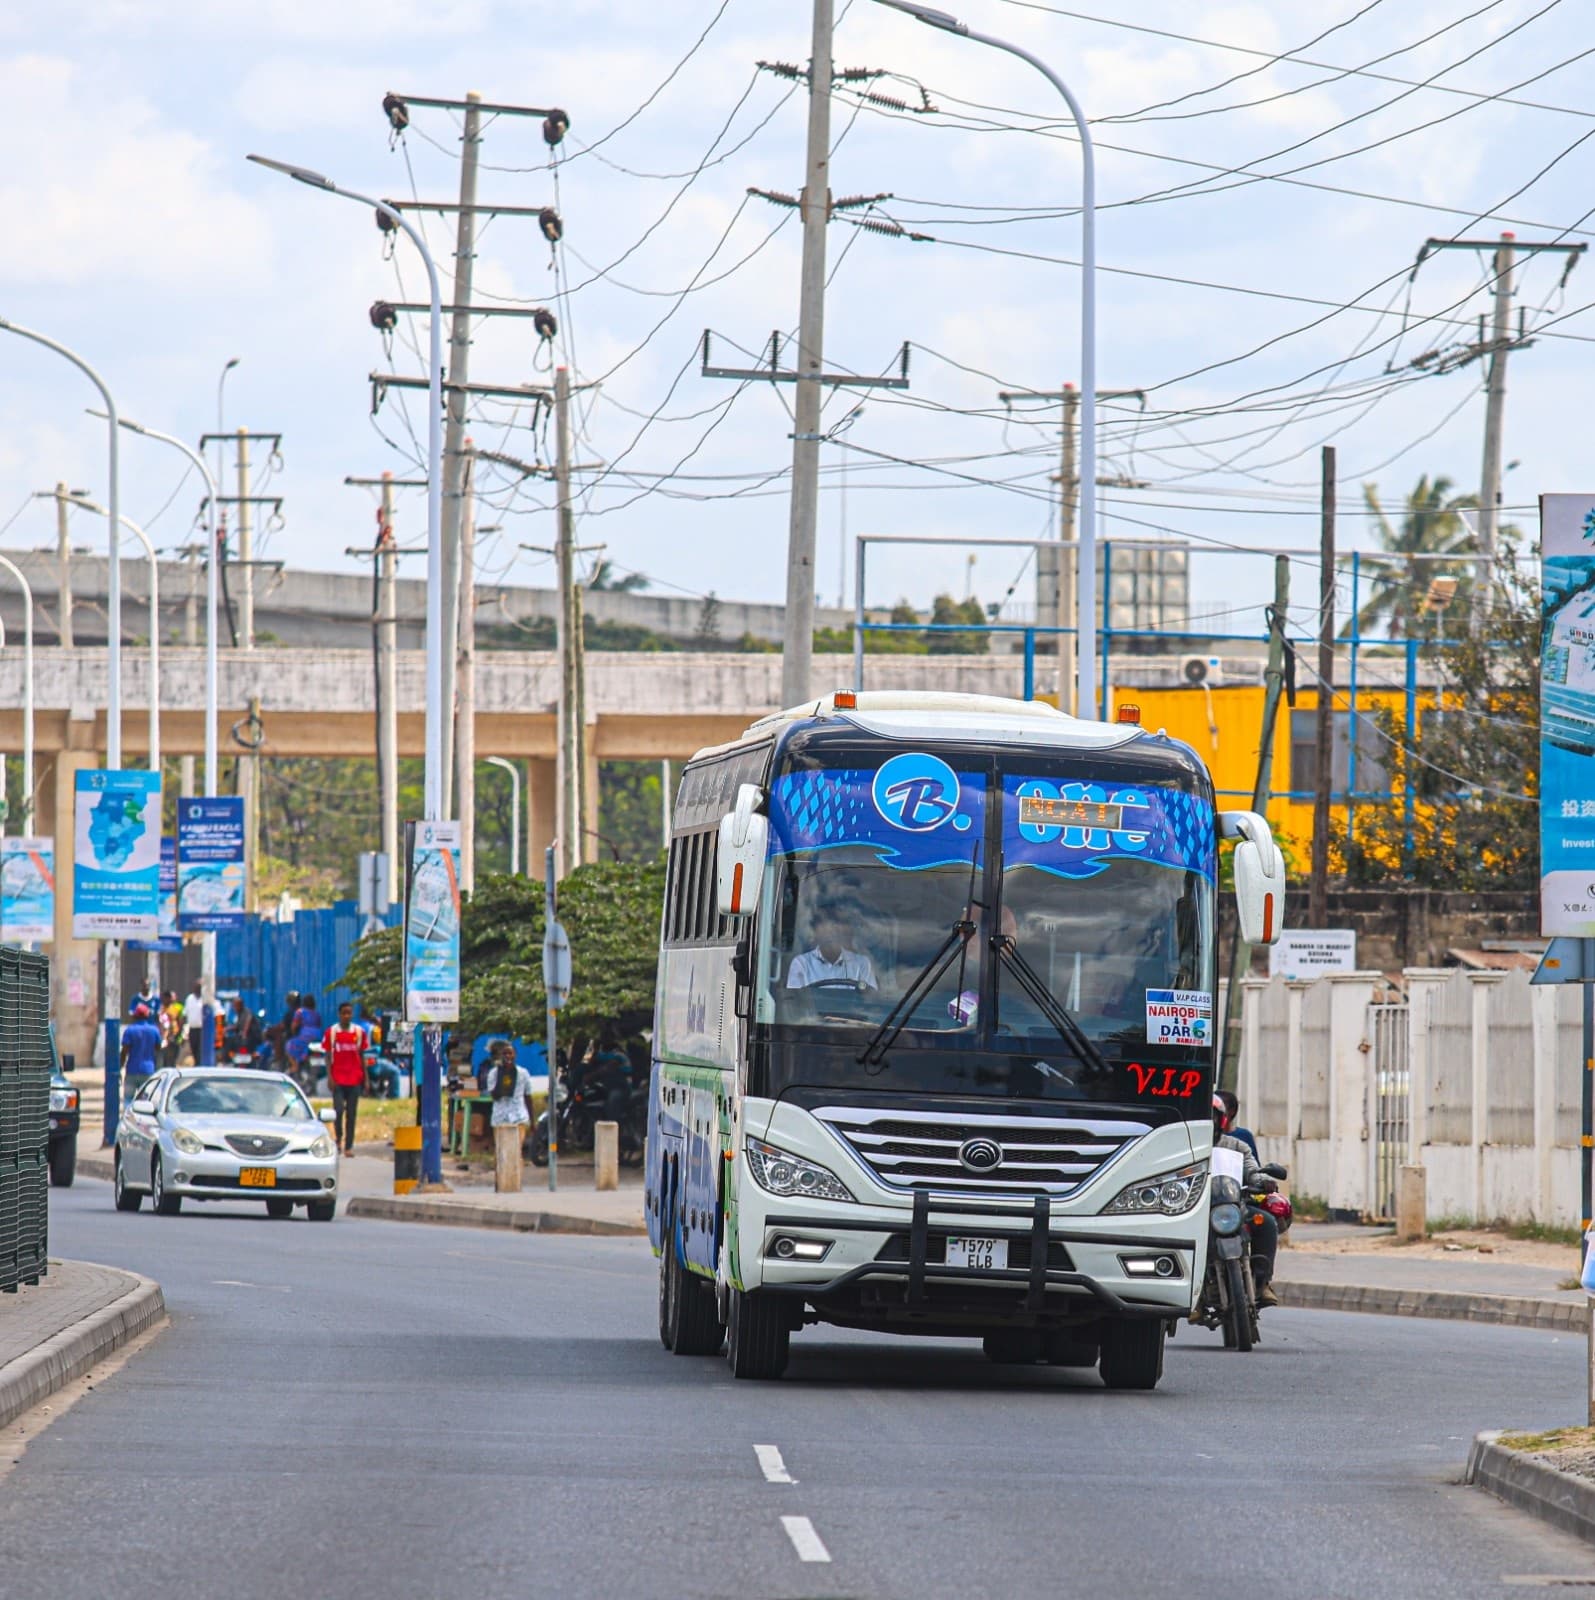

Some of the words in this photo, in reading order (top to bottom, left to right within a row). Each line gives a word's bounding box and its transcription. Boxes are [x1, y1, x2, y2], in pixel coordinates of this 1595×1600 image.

[1191, 995, 1210, 1004] CLASS
[1148, 1005, 1198, 1018] NAIROBI
[1161, 1025, 1190, 1037] DAR
[960, 1239, 993, 1254] T579
[968, 1254, 993, 1269] ELB
